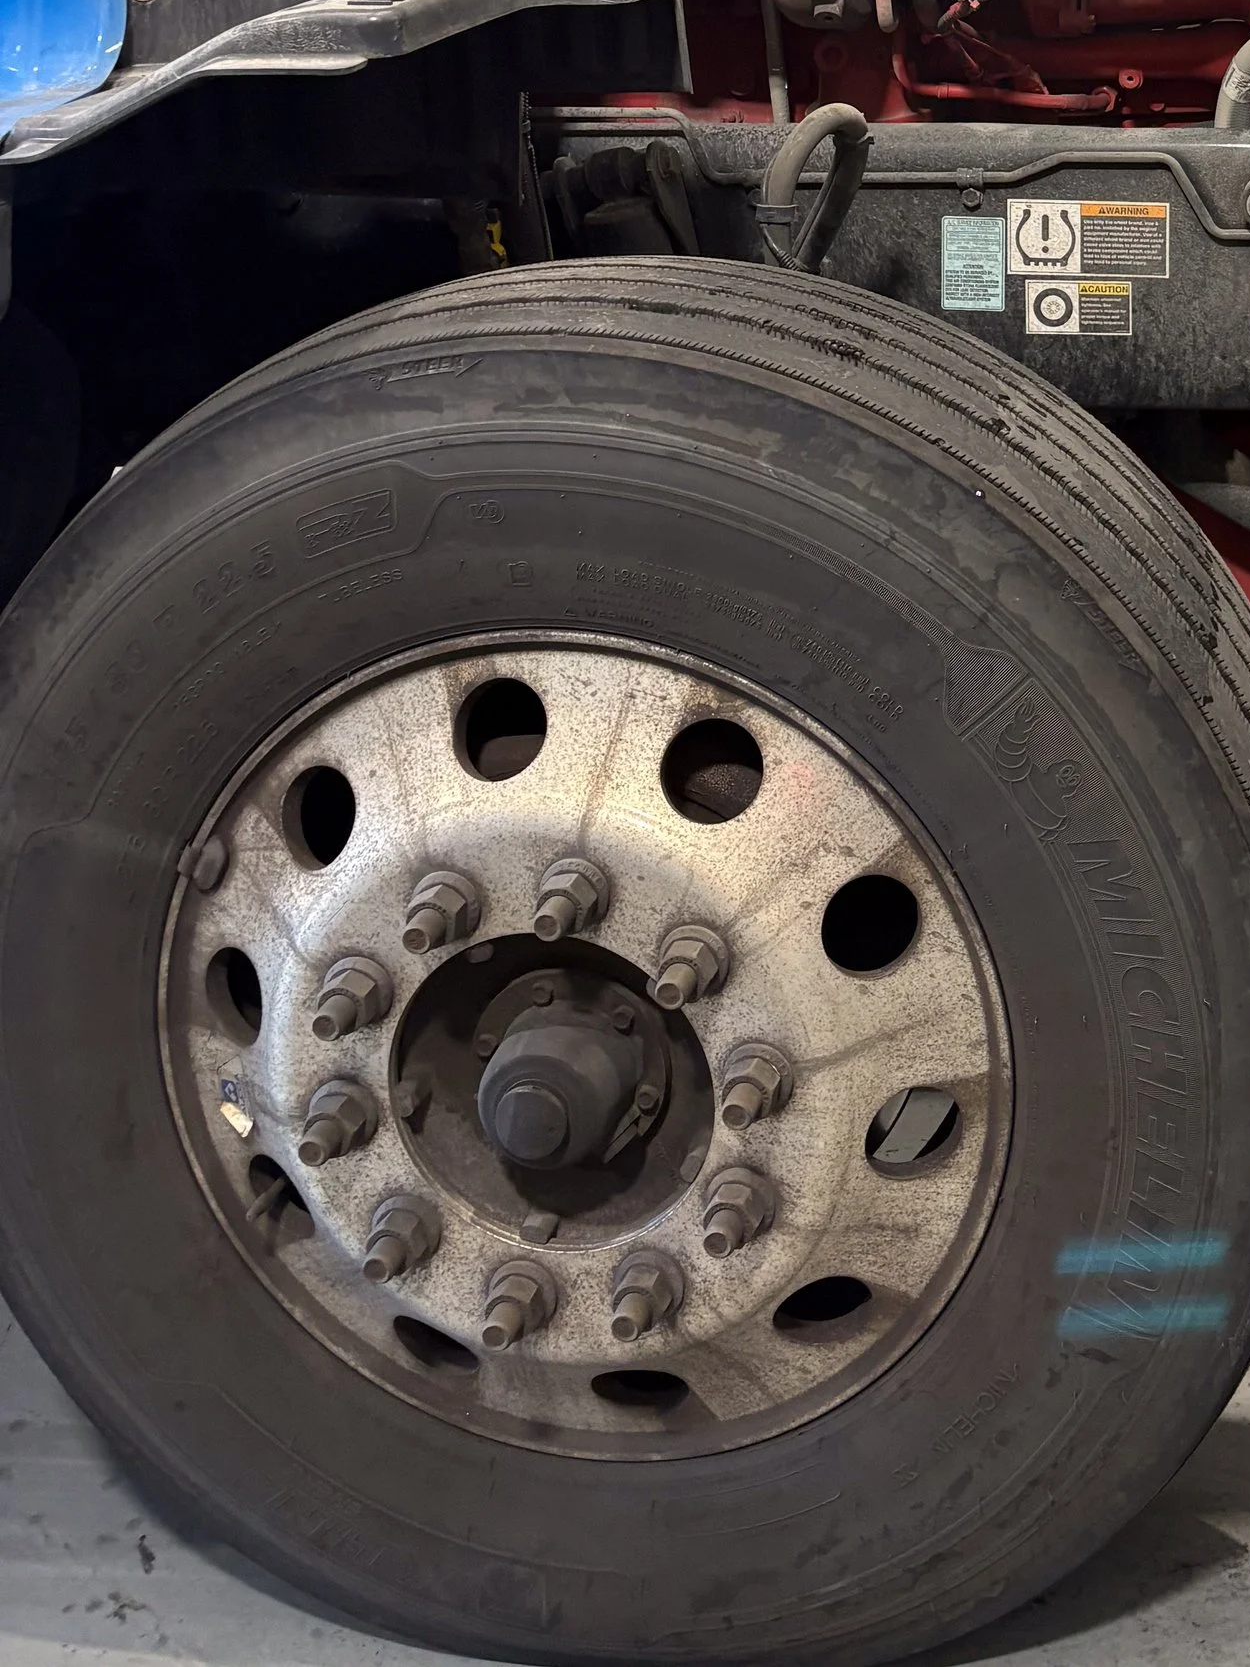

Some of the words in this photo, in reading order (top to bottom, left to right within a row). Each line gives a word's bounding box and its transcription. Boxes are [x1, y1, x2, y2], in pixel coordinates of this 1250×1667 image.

[1105, 206, 1149, 216] WARNING
[1088, 285, 1128, 293] CAUTION
[402, 355, 464, 375] STEER
[192, 539, 275, 614] 22.5
[318, 568, 403, 602] TUBELESS
[1069, 838, 1190, 1319] MICHELIN
[933, 1363, 1021, 1453] MICHELIN
